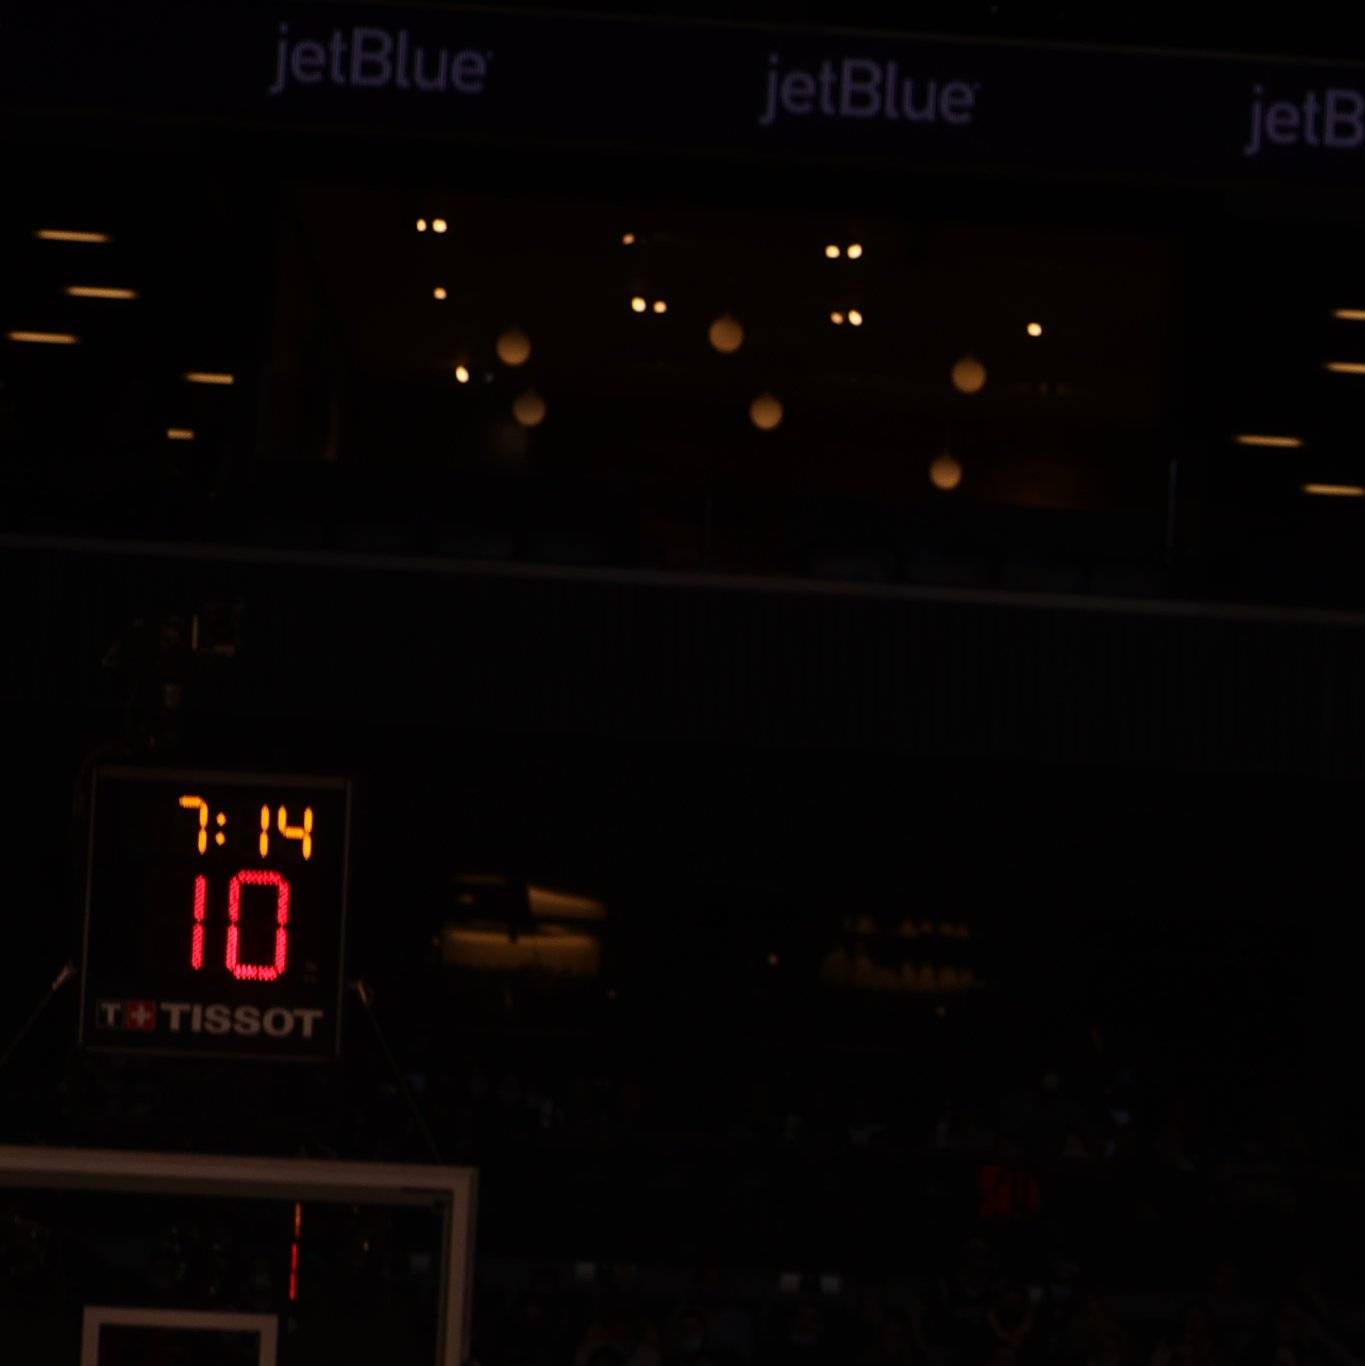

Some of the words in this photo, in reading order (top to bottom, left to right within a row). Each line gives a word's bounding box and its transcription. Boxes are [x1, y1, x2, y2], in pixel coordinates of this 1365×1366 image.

[267, 20, 493, 97] jetBlue
[757, 51, 982, 128] jetBlue
[178, 794, 315, 861] 7:14
[189, 867, 291, 983] 10
[157, 1001, 325, 1038] TISSOT
